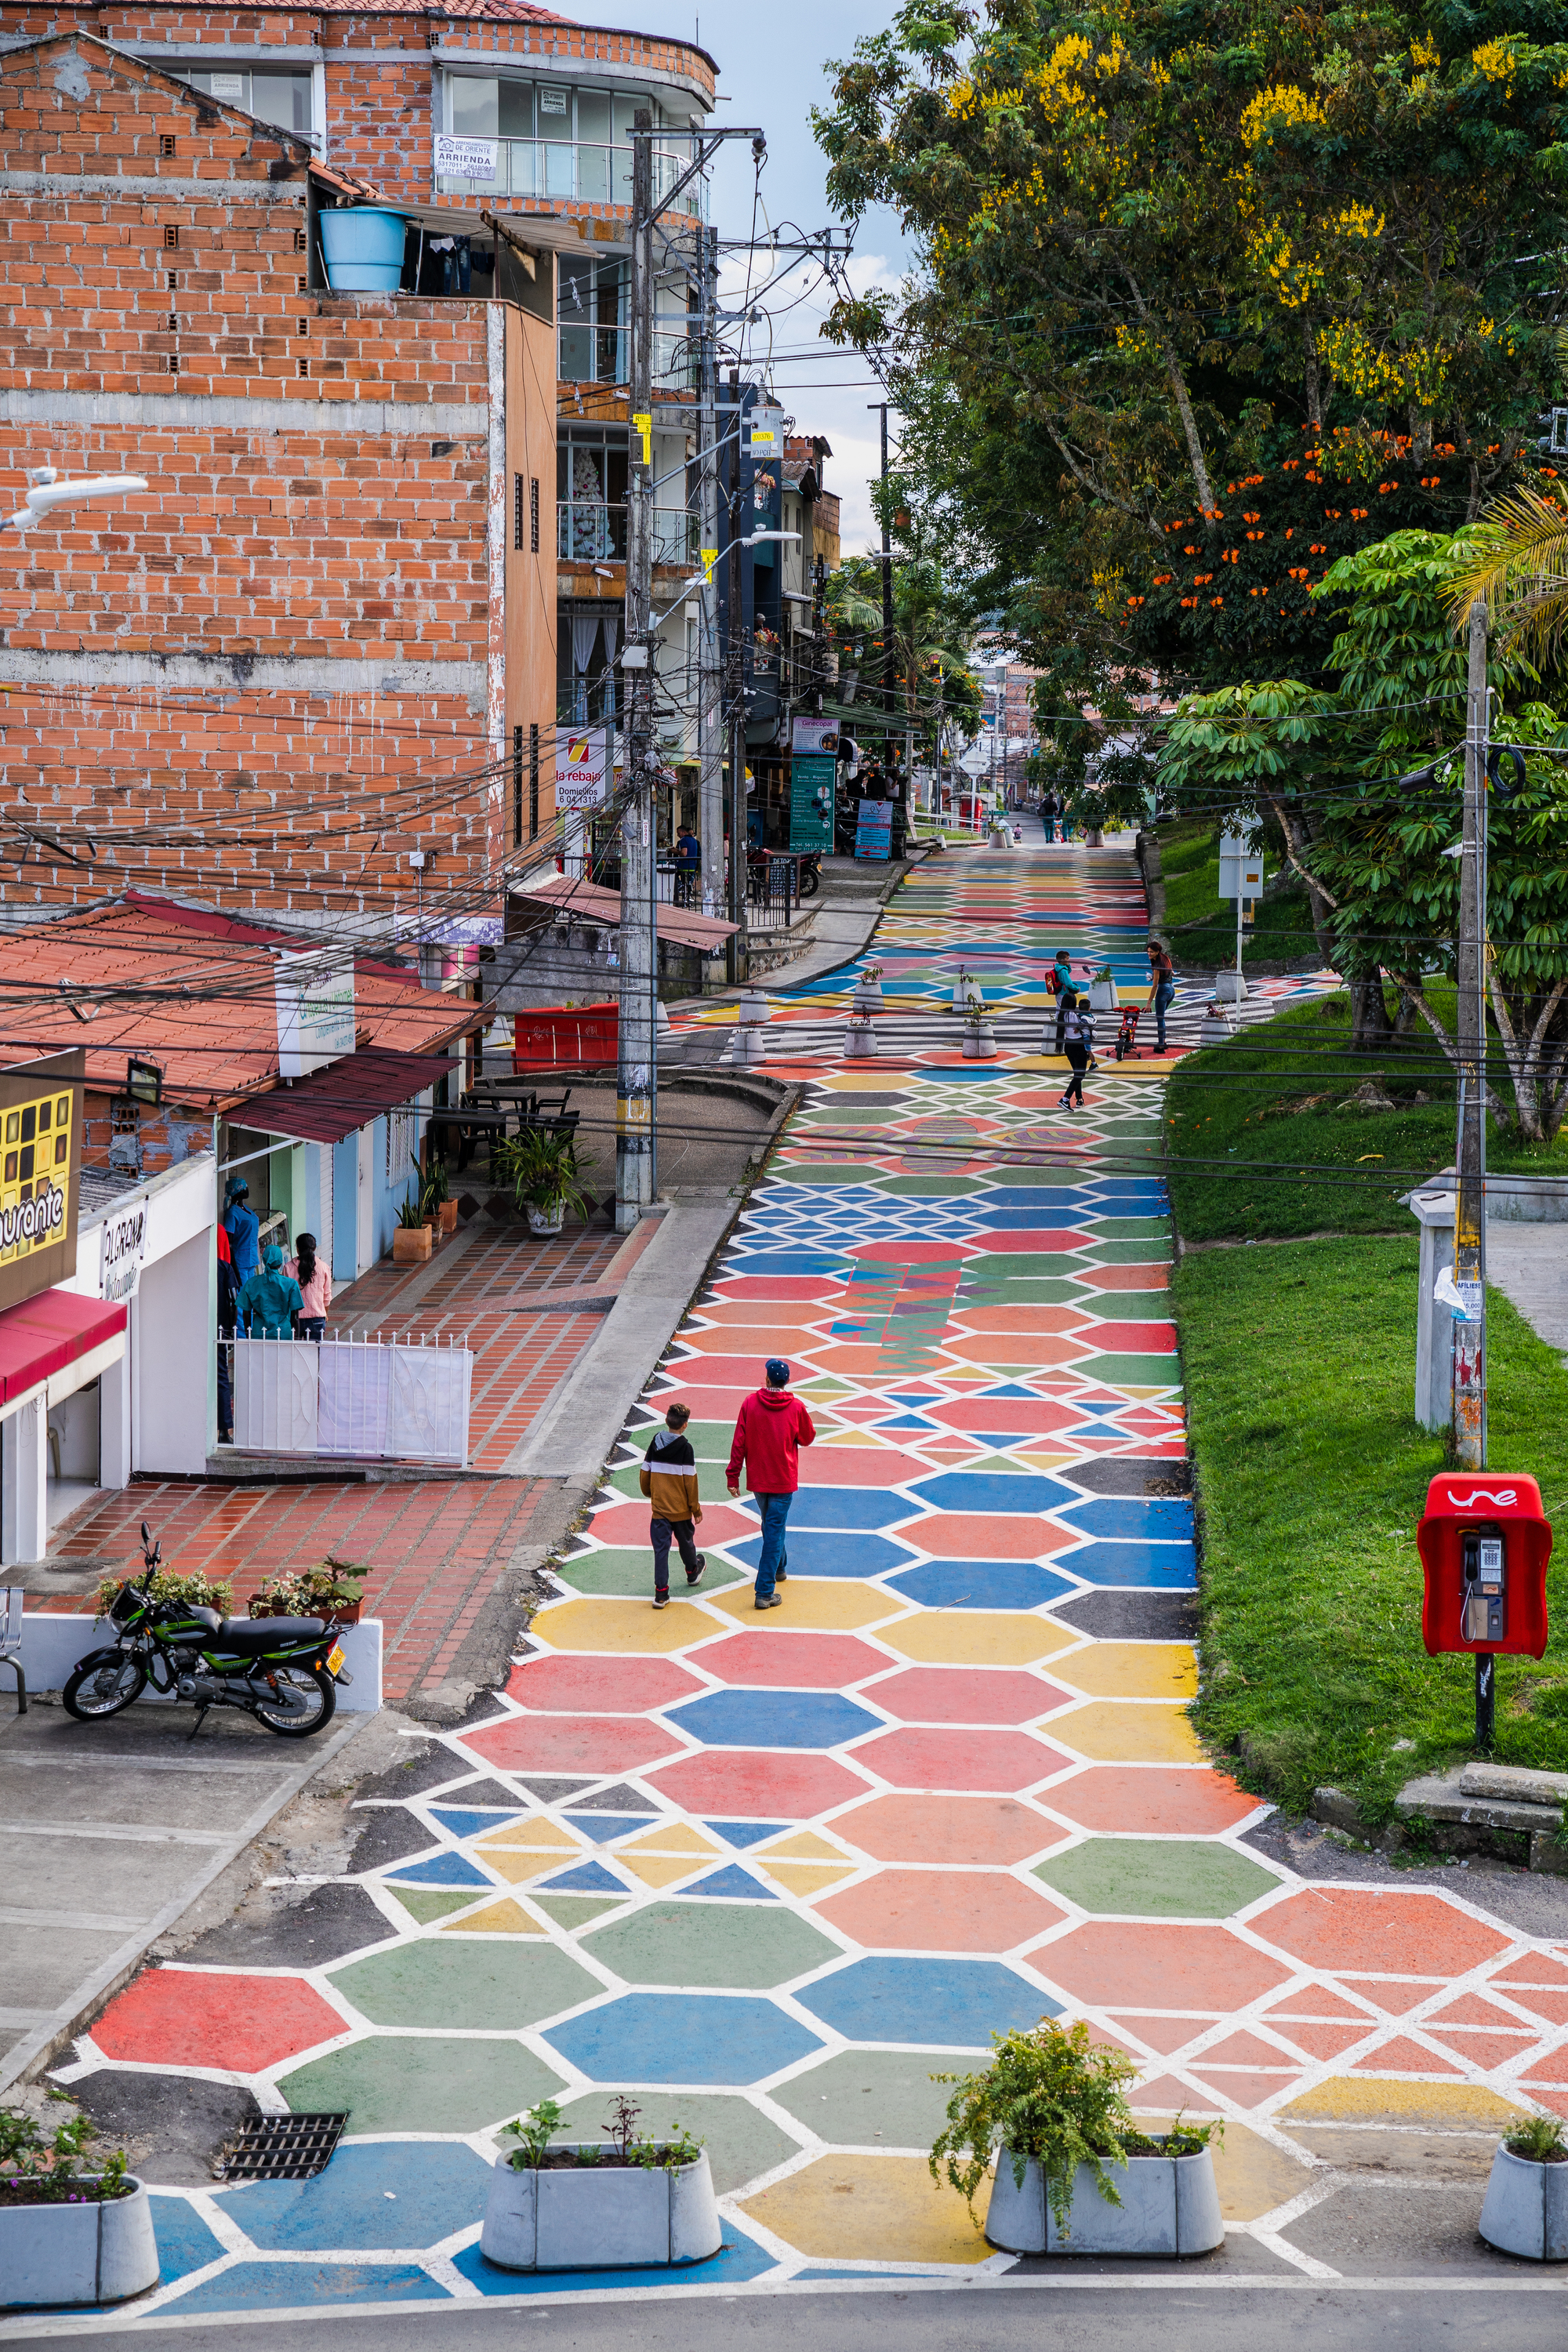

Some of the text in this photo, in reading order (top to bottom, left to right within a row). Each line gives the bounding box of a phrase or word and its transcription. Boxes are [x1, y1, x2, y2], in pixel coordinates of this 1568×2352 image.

[439, 153, 491, 165] ARRIENDA
[753, 433, 771, 441] 200376
[556, 770, 564, 781] la
[568, 770, 601, 783] rebaja
[559, 787, 598, 796] Domicilios
[1447, 1490, 1517, 1507] une
